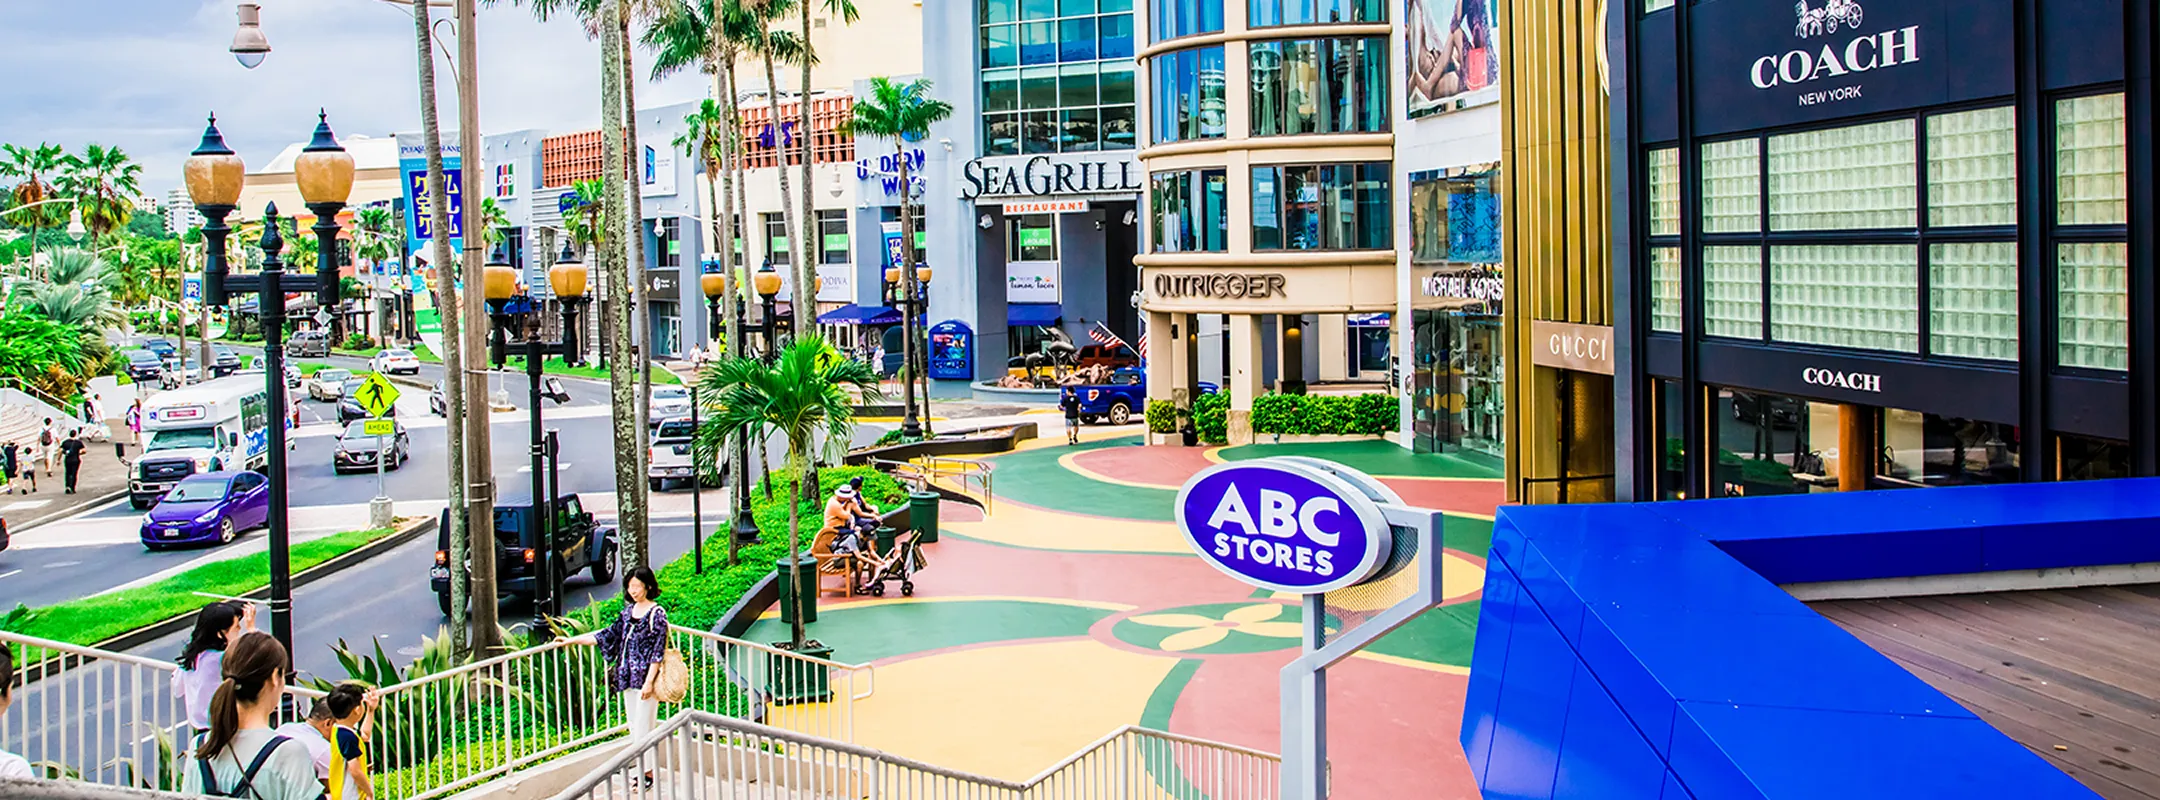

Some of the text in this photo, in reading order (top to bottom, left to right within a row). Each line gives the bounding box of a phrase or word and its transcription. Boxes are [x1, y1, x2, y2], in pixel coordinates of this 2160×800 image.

[1750, 25, 1919, 88] COACH
[1799, 85, 1863, 106] NEW YORK
[1006, 202, 1084, 213] RESTAURANT
[822, 276, 848, 286] ODIVA
[1155, 273, 1287, 299] OUTRIGGER
[1421, 276, 1504, 301] MICHAEL KORS
[1550, 333, 1606, 361] GUCCI
[1802, 367, 1881, 392] COACH
[368, 423, 390, 431] AHEAD
[1207, 481, 1340, 547] ABC
[1213, 532, 1334, 576] STORES
